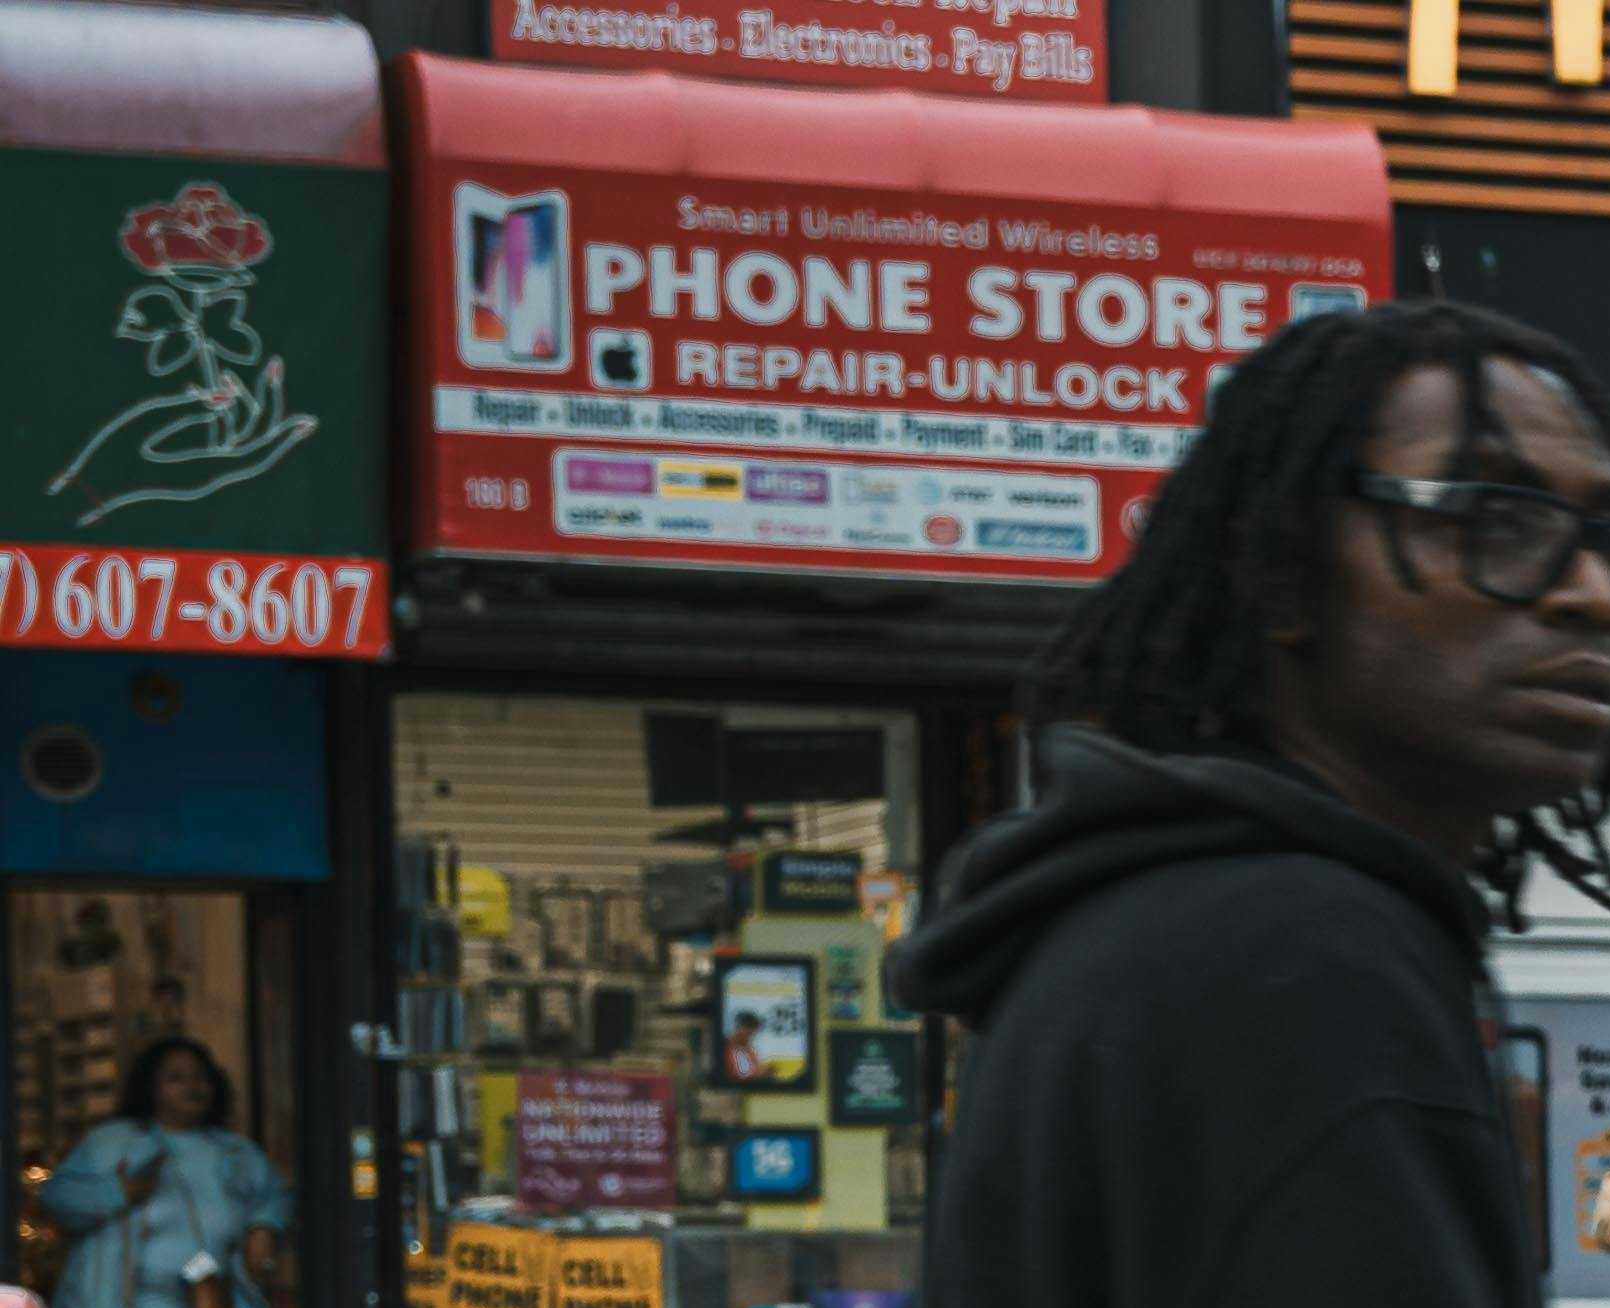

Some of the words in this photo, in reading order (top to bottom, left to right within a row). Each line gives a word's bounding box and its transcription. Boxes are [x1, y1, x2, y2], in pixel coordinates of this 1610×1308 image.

[511, 0, 717, 54] Accessories
[738, 9, 932, 71] Electronics
[952, 26, 1016, 91] Pay
[1020, 32, 1094, 83] Bills
[678, 196, 789, 237] Smart
[801, 207, 989, 249] Unlimited
[998, 219, 1160, 261] Wireless
[585, 243, 932, 333] PHONE
[967, 266, 1267, 350] STORE
[676, 340, 1190, 413] REPAIR-UNLOCK
[474, 390, 541, 427] Repair
[565, 396, 632, 429] Unlock
[658, 400, 780, 437] Accessories
[801, 407, 880, 447] Prepaid
[901, 411, 987, 452] Payment
[54, 554, 373, 650] 607-8607
